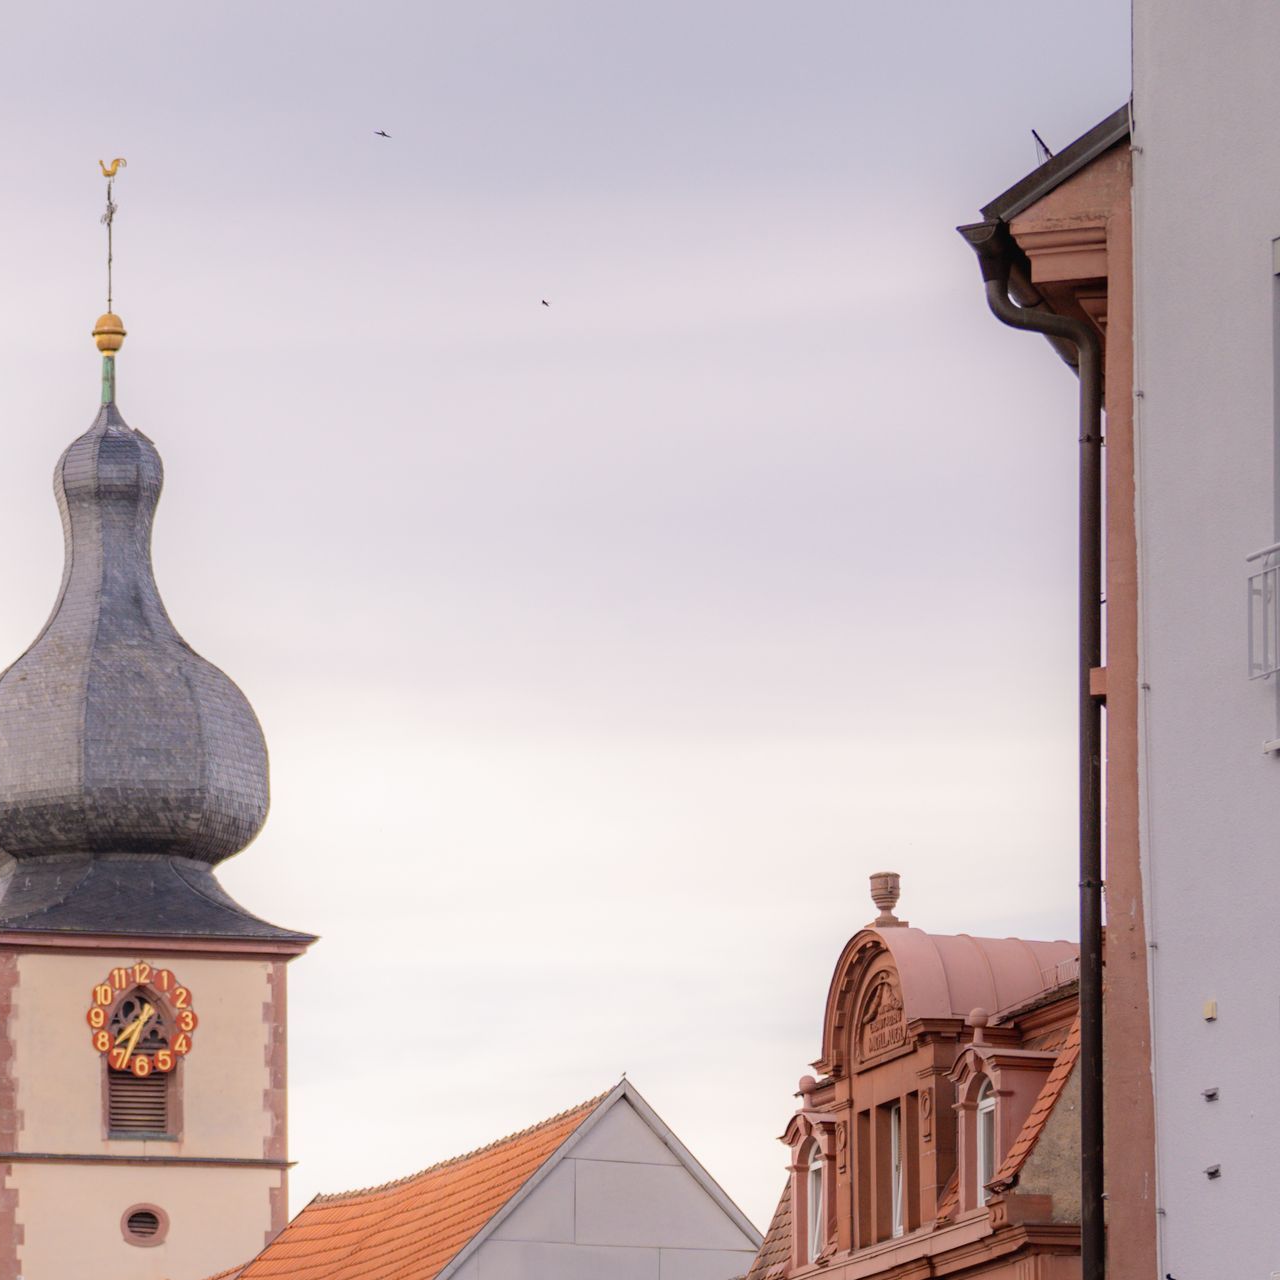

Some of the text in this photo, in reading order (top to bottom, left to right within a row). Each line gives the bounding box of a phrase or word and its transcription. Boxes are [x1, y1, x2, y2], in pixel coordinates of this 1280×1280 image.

[113, 968, 126, 989] 11
[134, 964, 150, 984] 12
[162, 970, 168, 990] 1
[95, 984, 112, 1006] 10
[176, 988, 187, 1008] 2
[90, 1009, 104, 1028] 9
[181, 1011, 194, 1031] 3
[96, 1031, 110, 1051] 8
[174, 1034, 188, 1054] 4
[112, 1048, 126, 1069] 7
[135, 1054, 149, 1076] 6
[158, 1050, 171, 1070] 5
